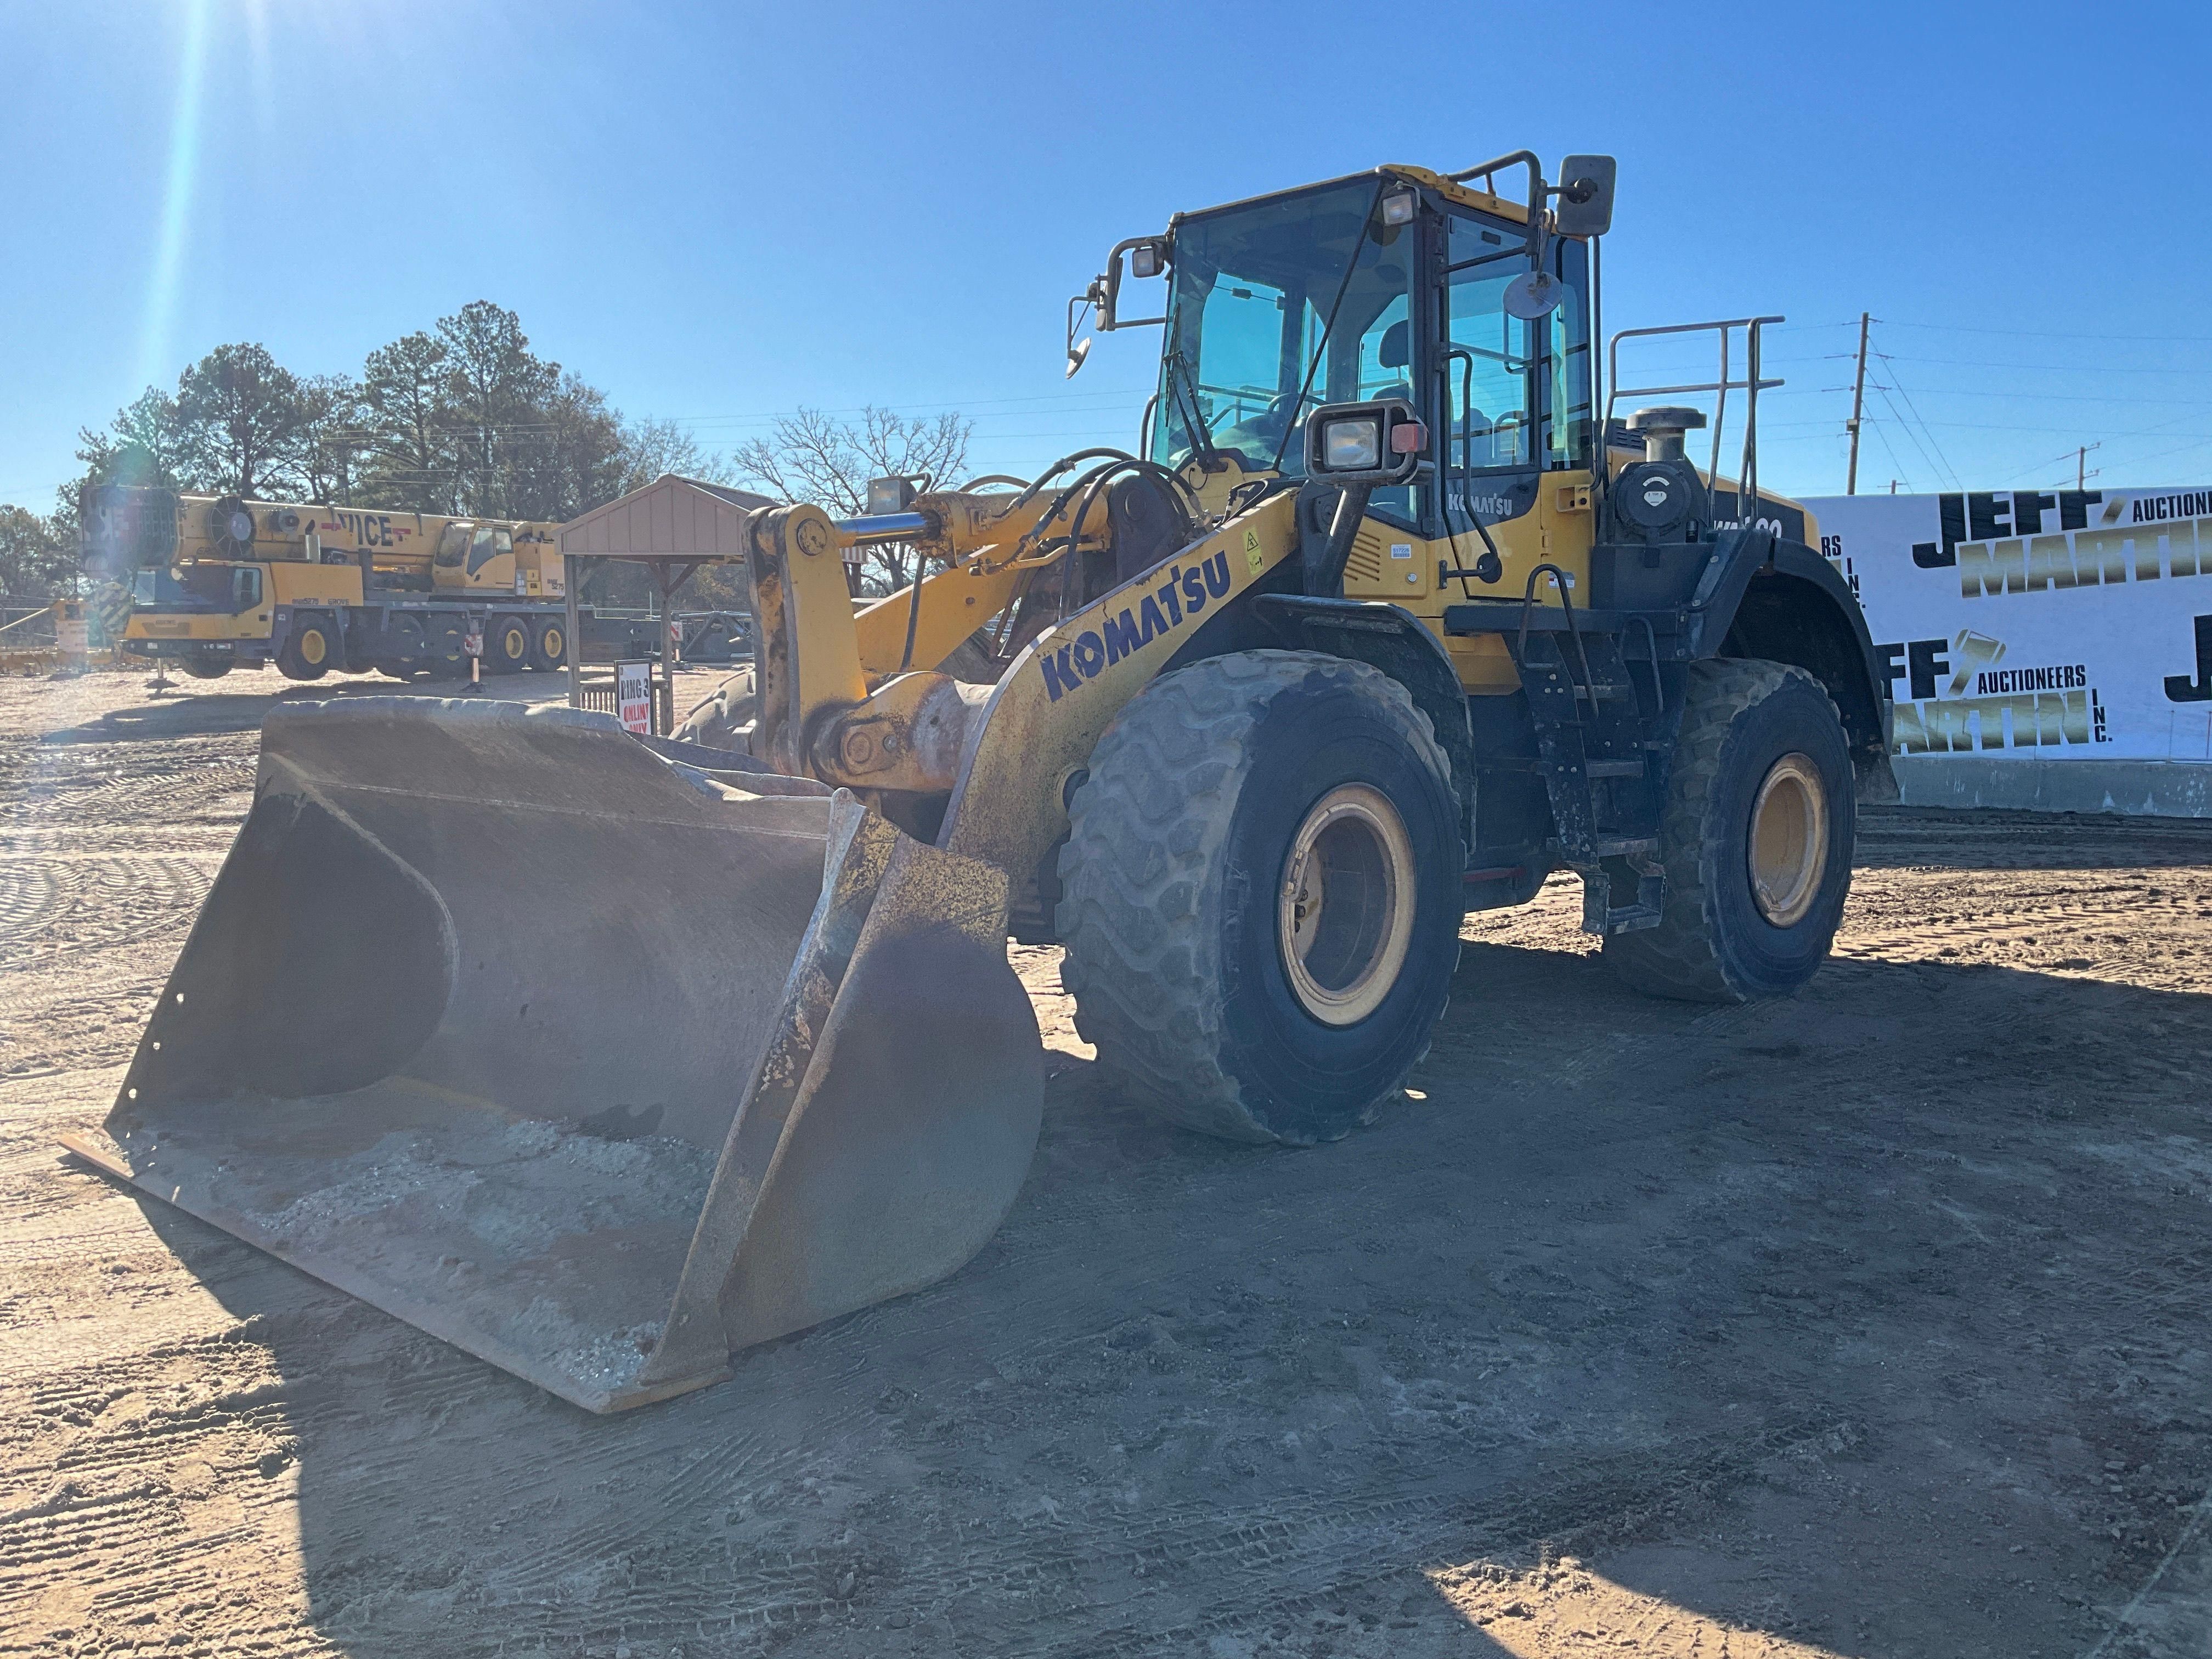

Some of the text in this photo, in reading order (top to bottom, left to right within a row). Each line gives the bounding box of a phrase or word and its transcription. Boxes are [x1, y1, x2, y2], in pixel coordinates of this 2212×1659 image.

[1912, 490, 2102, 568] JEFF
[1040, 550, 1231, 703] KOMATSU
[620, 678, 650, 700] RING 3
[1978, 664, 2086, 695] AUCTIONEERS
[2092, 689, 2113, 743] INC.
